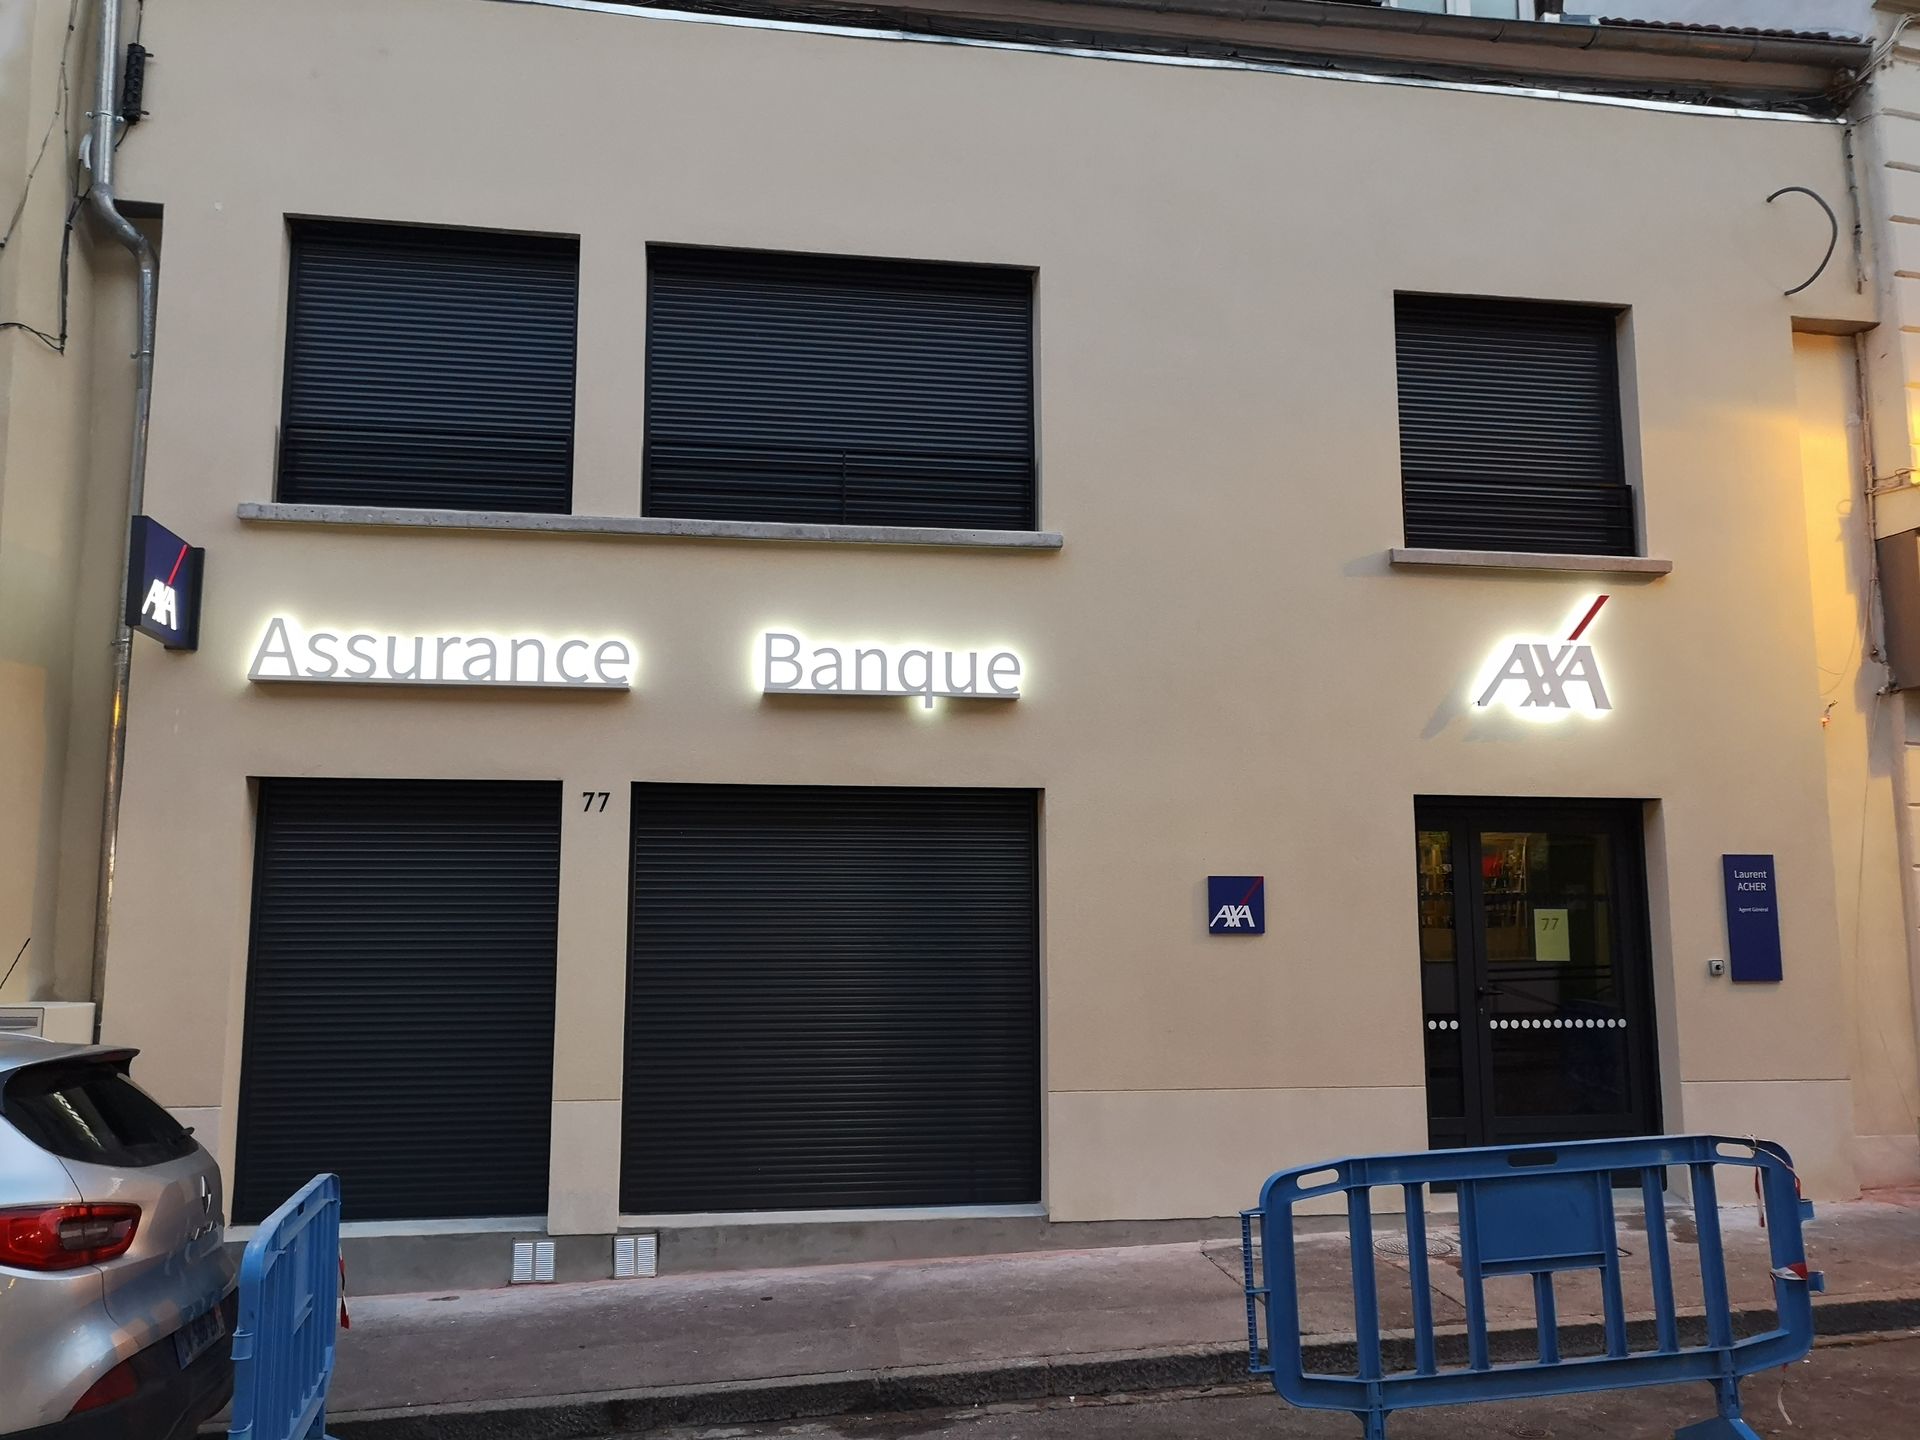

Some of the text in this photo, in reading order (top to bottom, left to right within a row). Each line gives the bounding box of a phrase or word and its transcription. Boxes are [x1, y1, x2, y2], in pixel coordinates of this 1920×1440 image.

[142, 579, 177, 630] AXA
[248, 618, 630, 684] Assurance
[765, 633, 1020, 708] Banque
[1478, 644, 1612, 709] AXA
[583, 792, 610, 812] 77
[1734, 870, 1767, 879] Laurent
[1737, 882, 1767, 891] ACHER
[1210, 905, 1255, 927] AXA
[1540, 917, 1559, 931] 77
